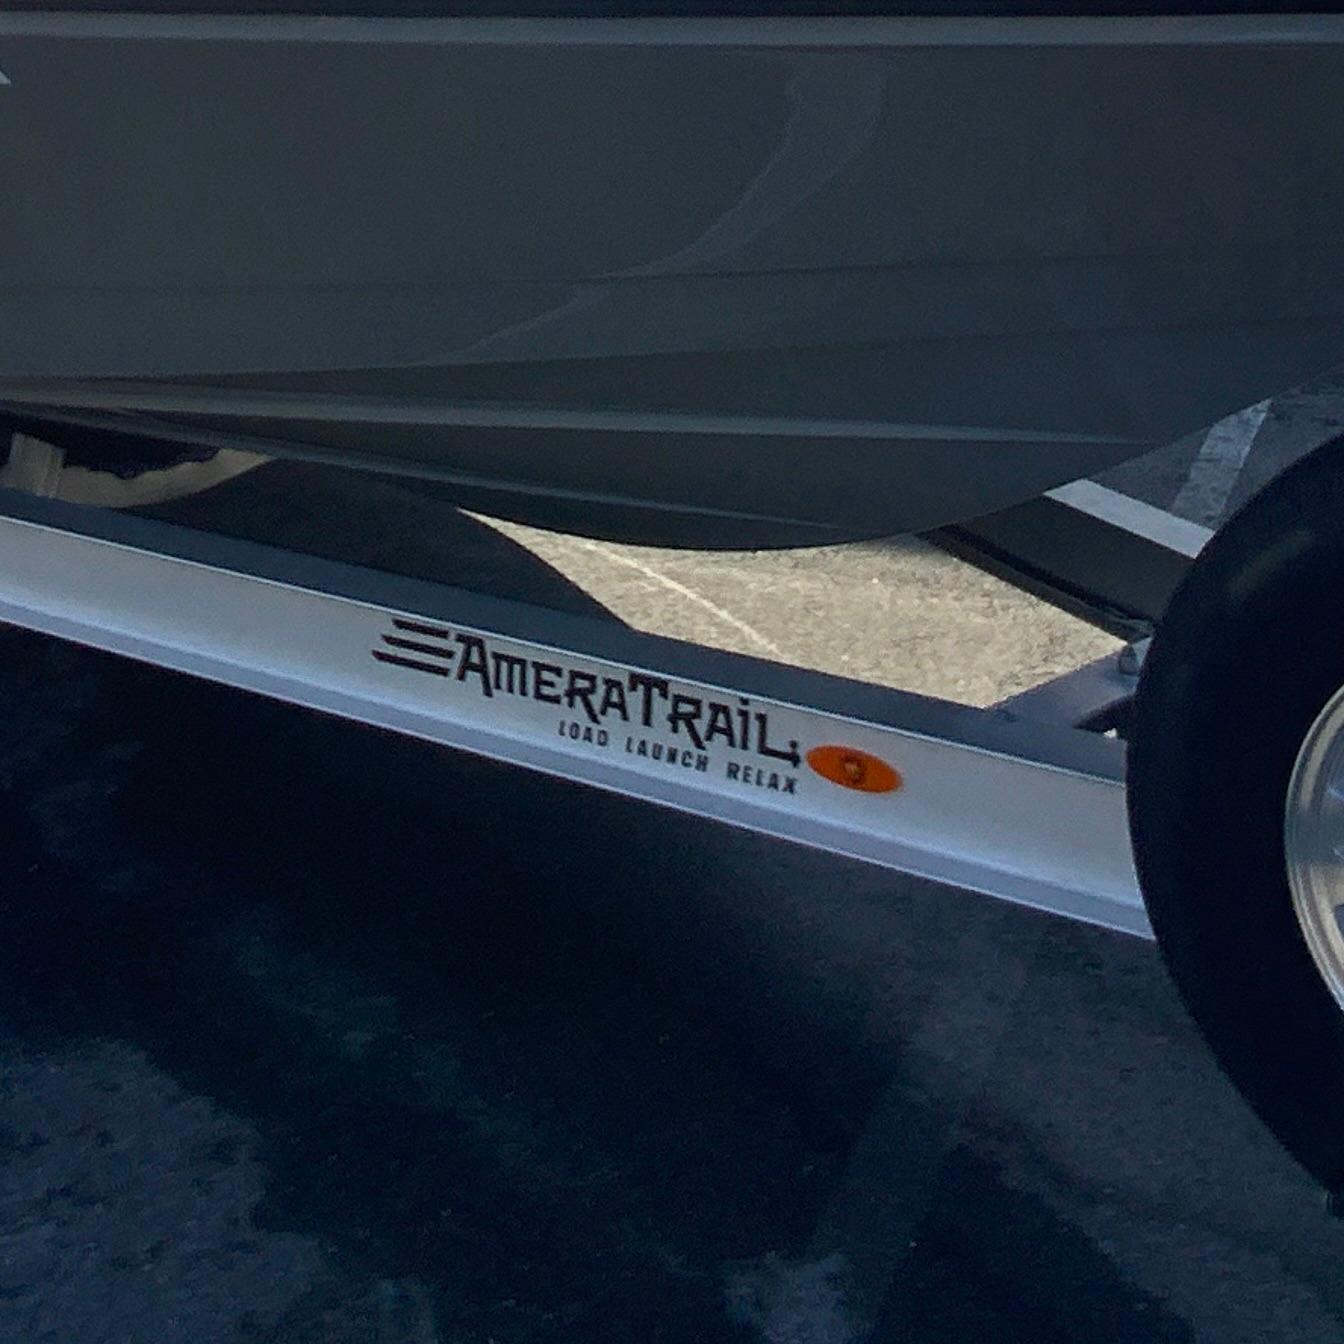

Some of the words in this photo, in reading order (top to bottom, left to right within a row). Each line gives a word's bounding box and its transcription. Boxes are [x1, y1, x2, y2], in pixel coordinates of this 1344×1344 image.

[557, 719, 609, 747] LOAD
[625, 737, 708, 773] LAUNCH
[726, 762, 798, 795] RELAX
